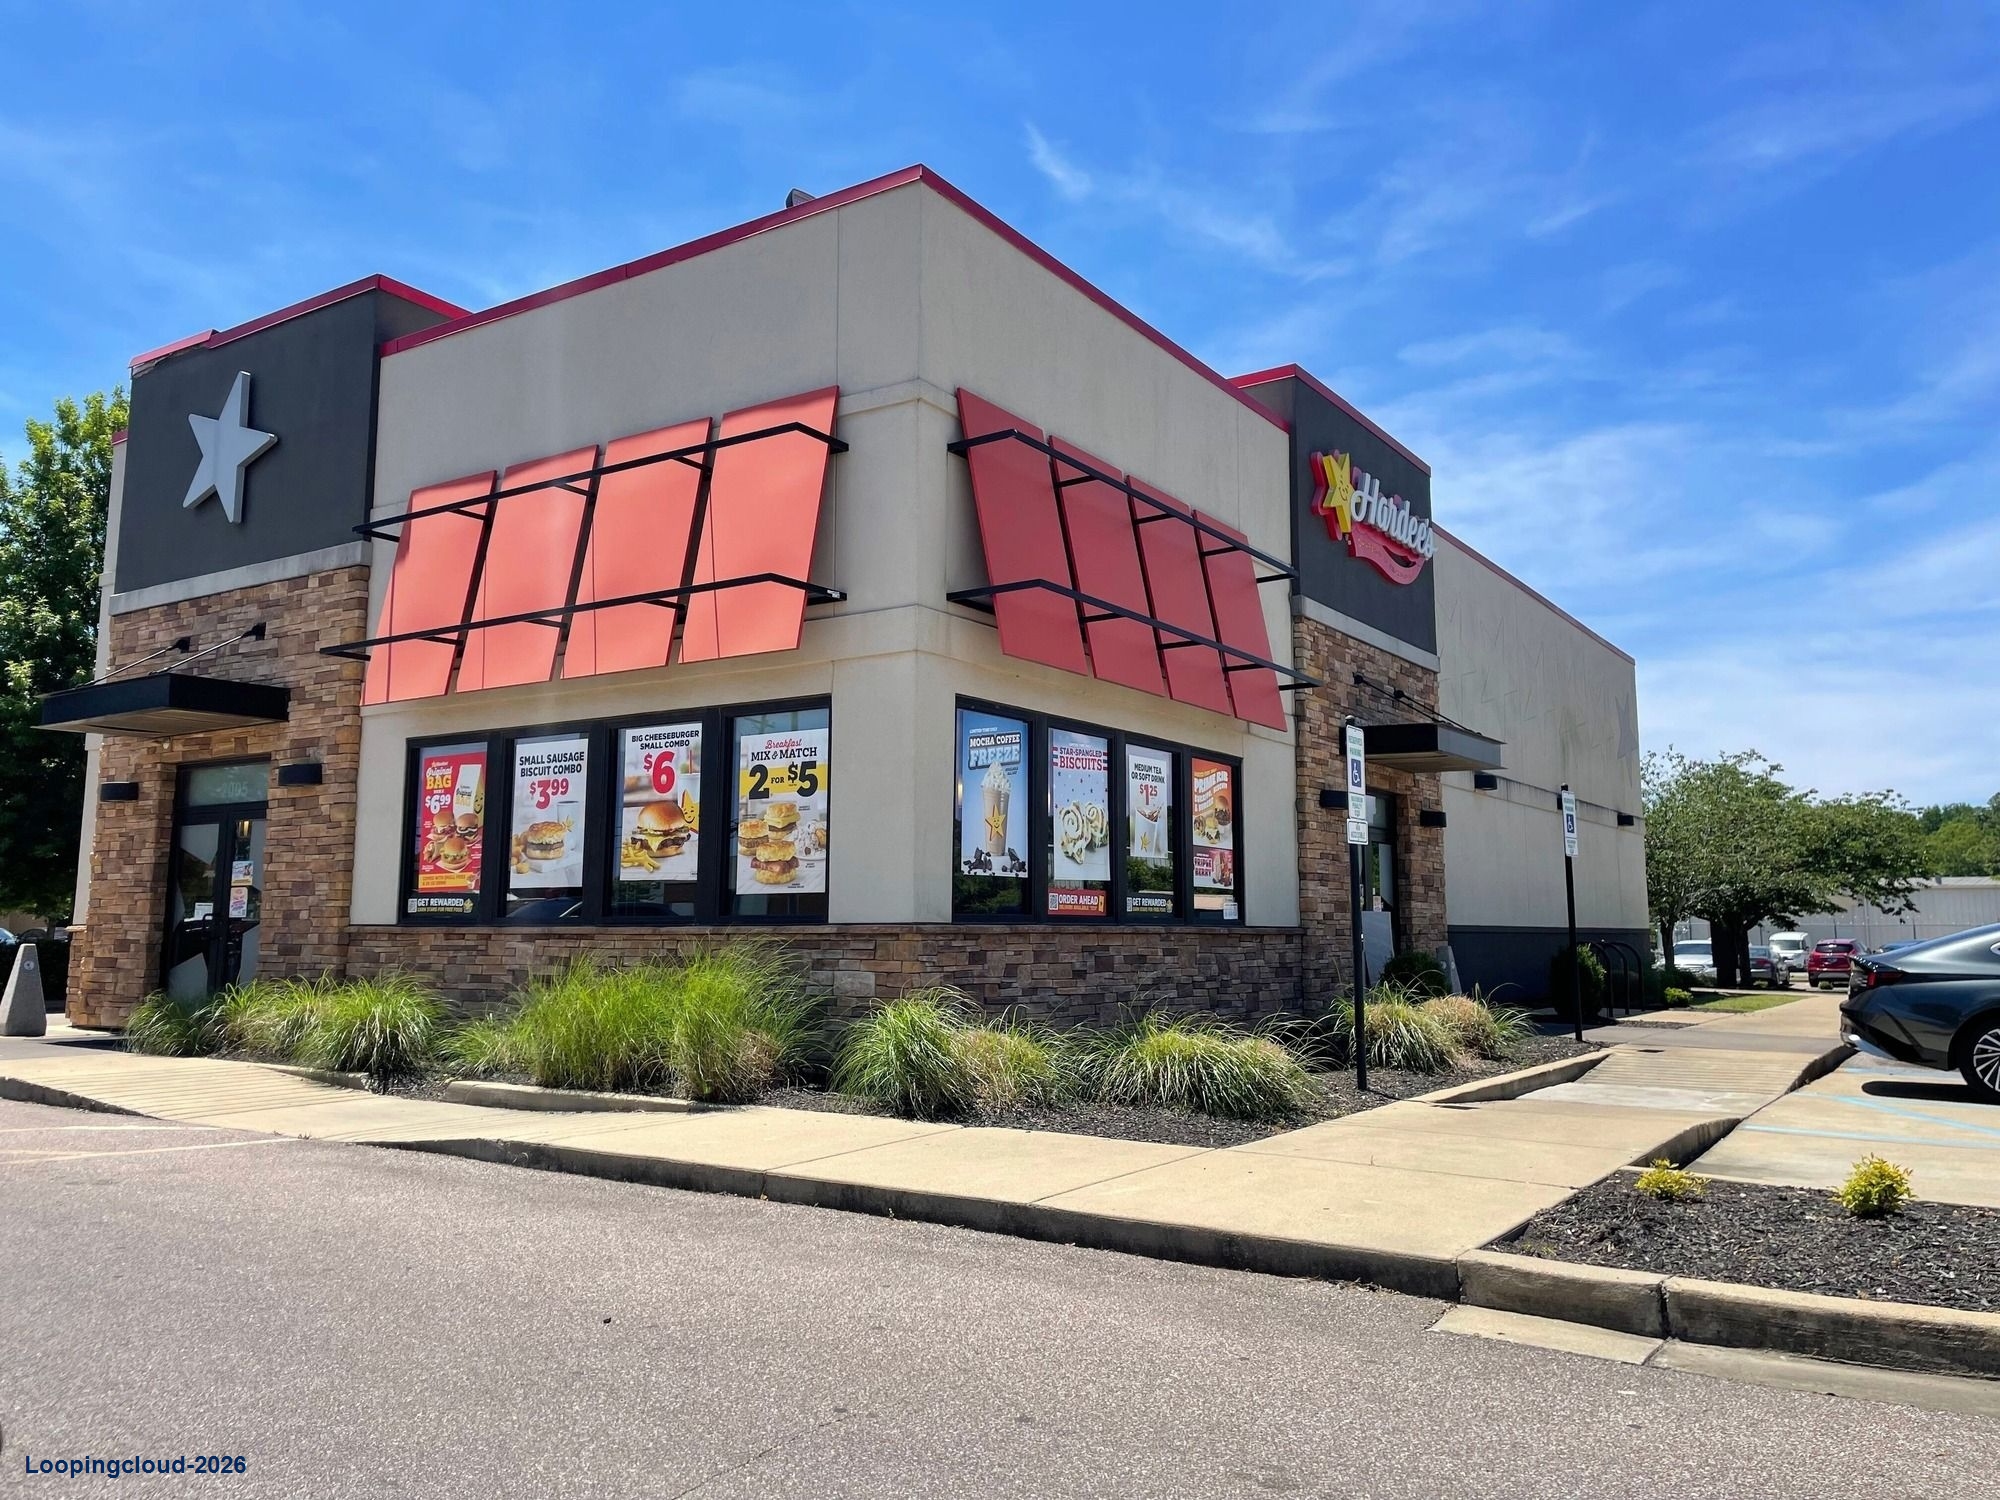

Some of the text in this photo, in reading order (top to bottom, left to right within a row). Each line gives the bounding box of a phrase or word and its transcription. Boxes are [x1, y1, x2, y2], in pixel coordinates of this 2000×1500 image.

[631, 730, 700, 743] BIG CHEESEBURGER
[970, 734, 1020, 747] MOCHA COFFEE
[640, 739, 690, 750] SMALL COMBO
[765, 738, 802, 750] Breakfast
[519, 751, 585, 766] SMALL SAUSAGE
[751, 747, 817, 761] MIX & MATCH
[969, 744, 1020, 768] FREEZE
[1060, 747, 1102, 757] STAR-SPANGLED
[520, 763, 582, 777] BISCUIT COMBO
[1059, 756, 1103, 771] BISCUITS
[1134, 763, 1162, 774] MEDIUM TEA
[643, 750, 676, 794] $6
[1131, 771, 1165, 783] OR SOFT DRINK
[426, 775, 452, 790] BAG
[749, 760, 818, 800] 2 FOR $5
[417, 898, 464, 907] GET REWARDED
[1058, 895, 1099, 905] ORDER AHEAD
